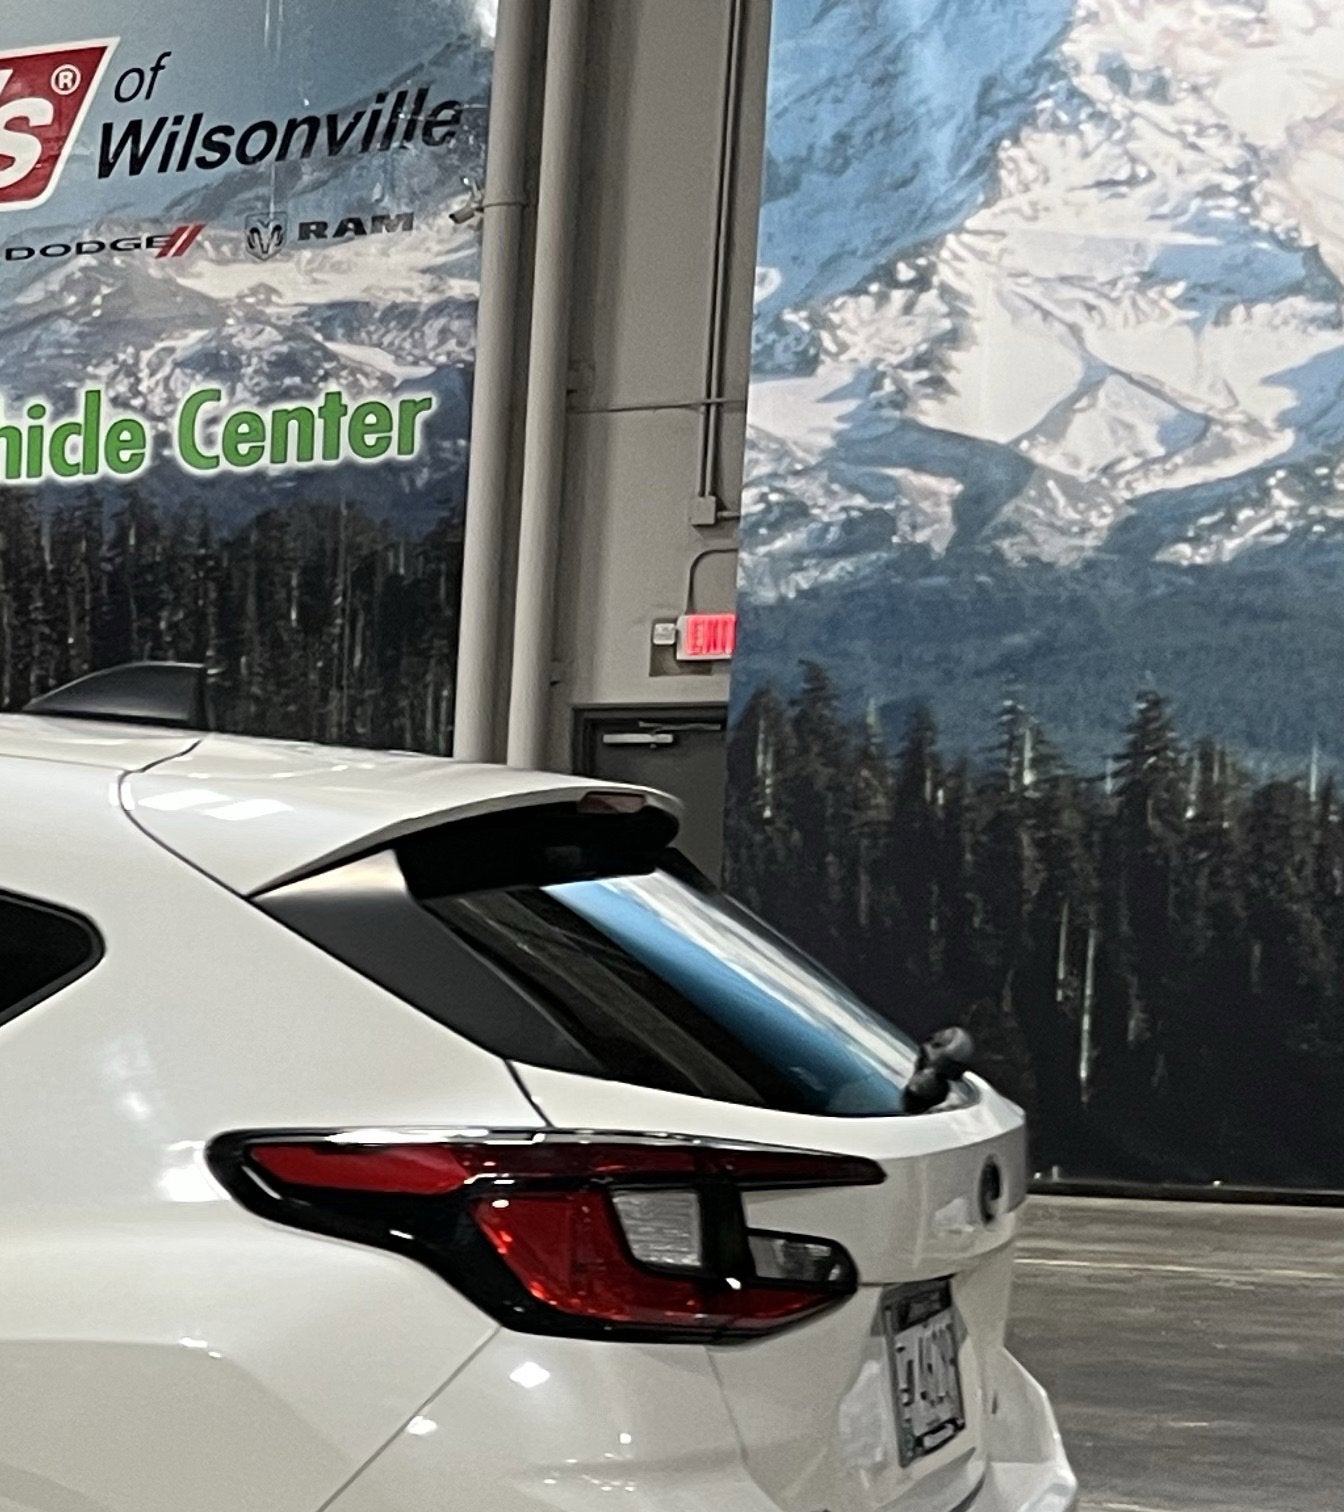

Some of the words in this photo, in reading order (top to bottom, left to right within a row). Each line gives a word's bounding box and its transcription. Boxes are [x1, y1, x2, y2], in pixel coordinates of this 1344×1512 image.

[114, 51, 172, 102] of
[98, 87, 462, 180] Wilsonville
[6, 236, 168, 261] DODGE
[298, 212, 415, 241] RAM
[178, 388, 433, 470] Center
